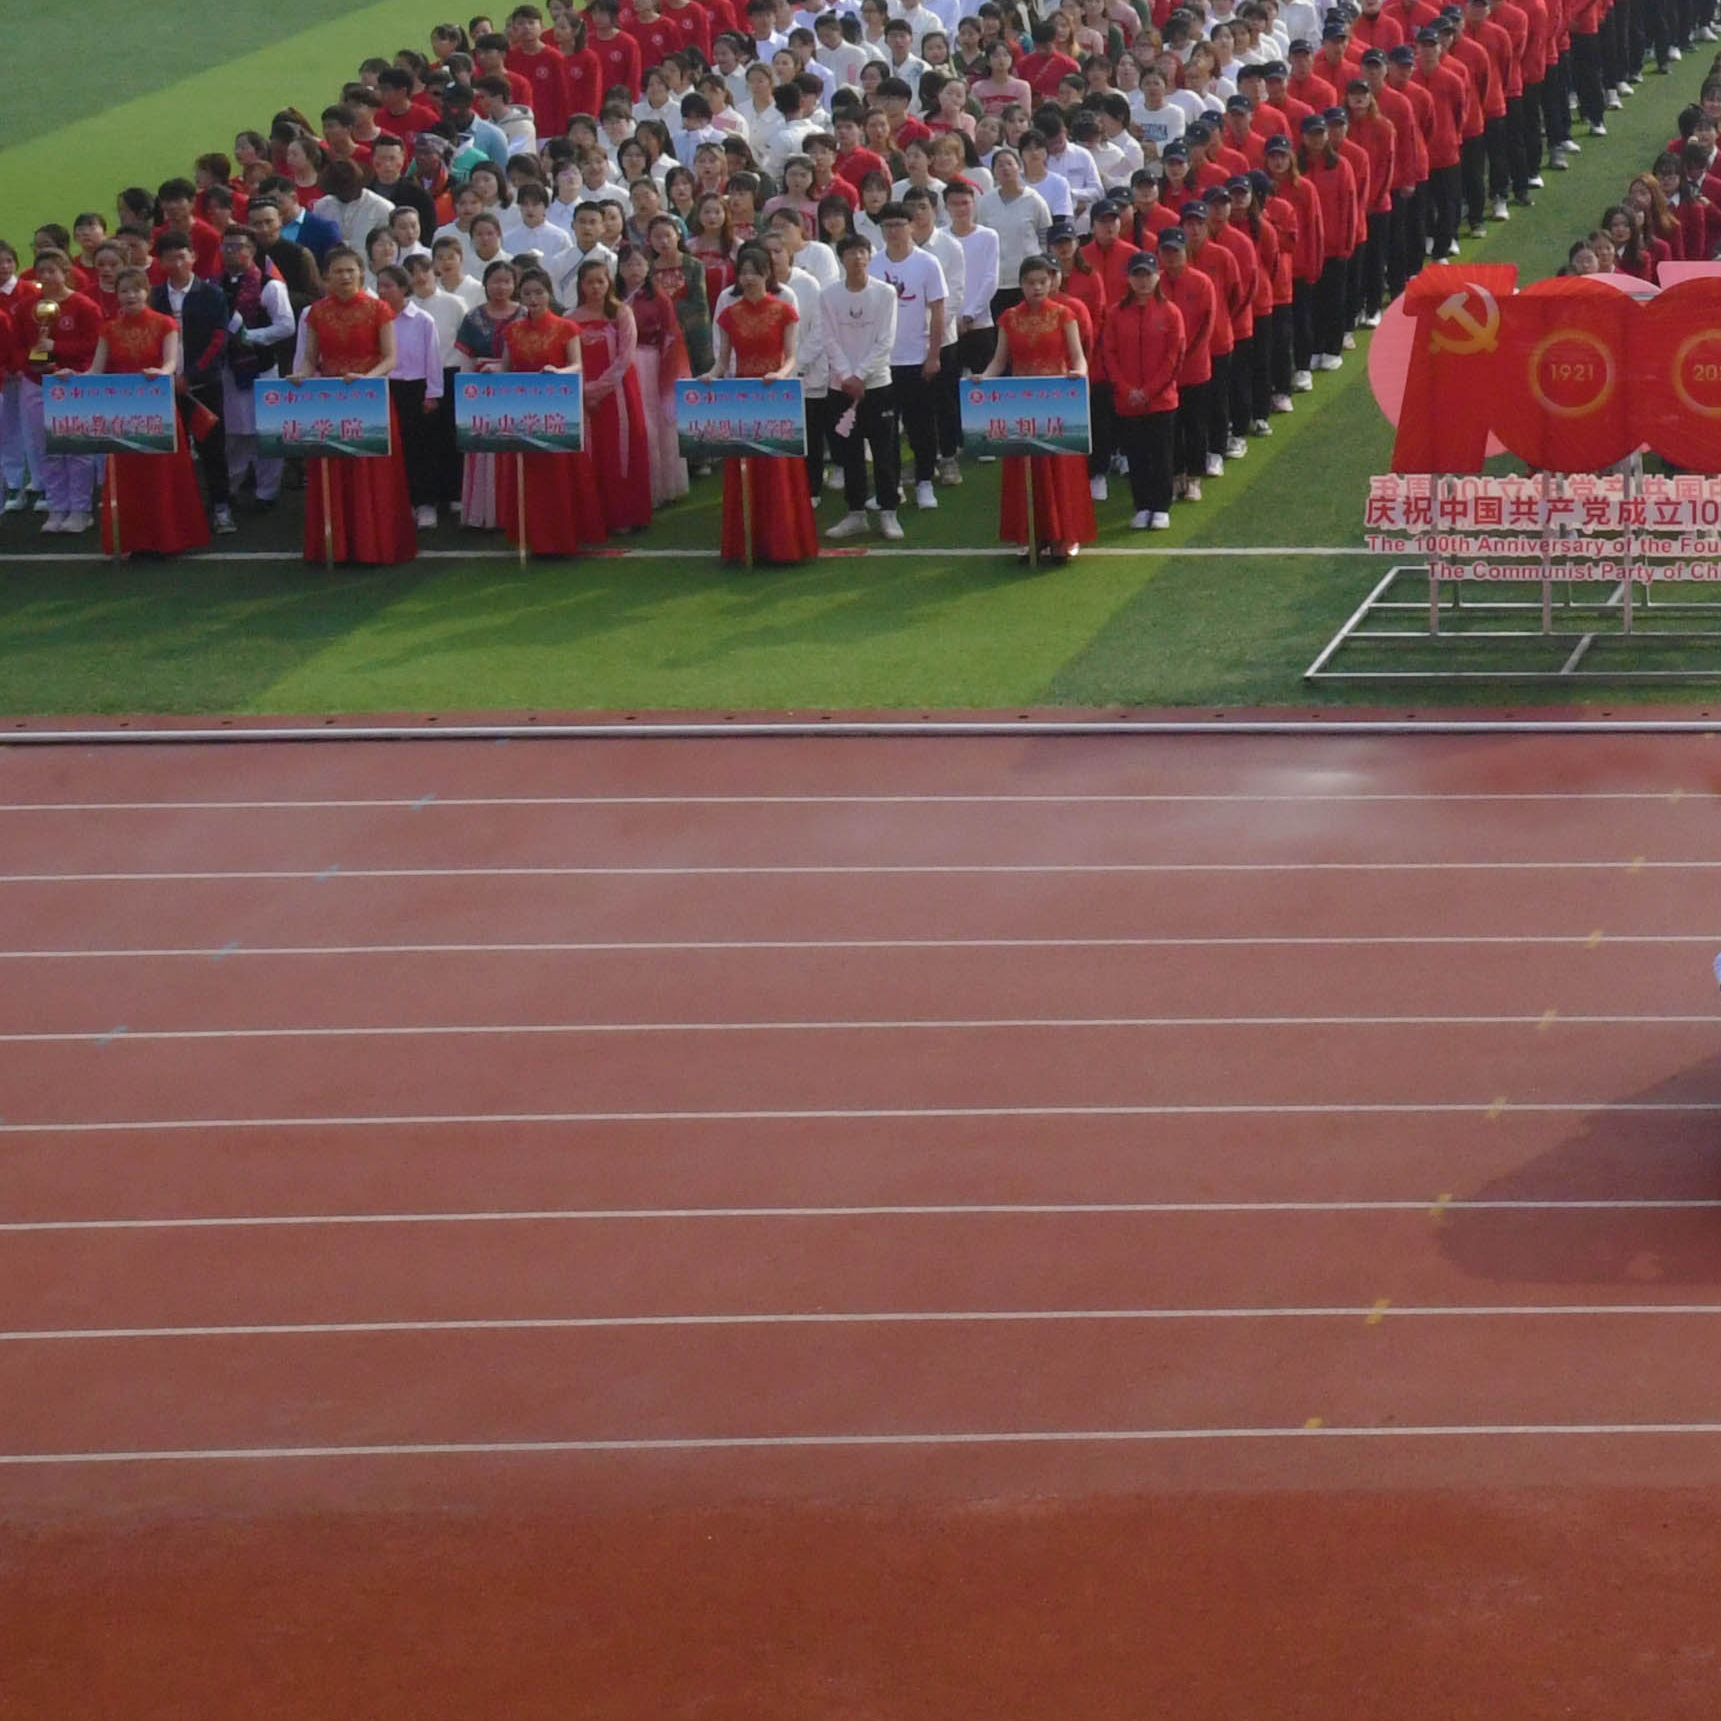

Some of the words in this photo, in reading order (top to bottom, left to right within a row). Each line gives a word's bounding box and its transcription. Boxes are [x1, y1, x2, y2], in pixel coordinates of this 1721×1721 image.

[1549, 364, 1595, 382] 1921
[282, 419, 365, 442] 法学院
[1368, 535, 1406, 552] The
[1415, 535, 1470, 552] 100th
[1477, 535, 1605, 557] Anniversary
[1613, 535, 1632, 553] of
[1641, 535, 1672, 553] the
[1427, 562, 1465, 579] The
[1473, 561, 1593, 579] Communist
[1601, 563, 1655, 583] Party
[1663, 563, 1683, 580] of
